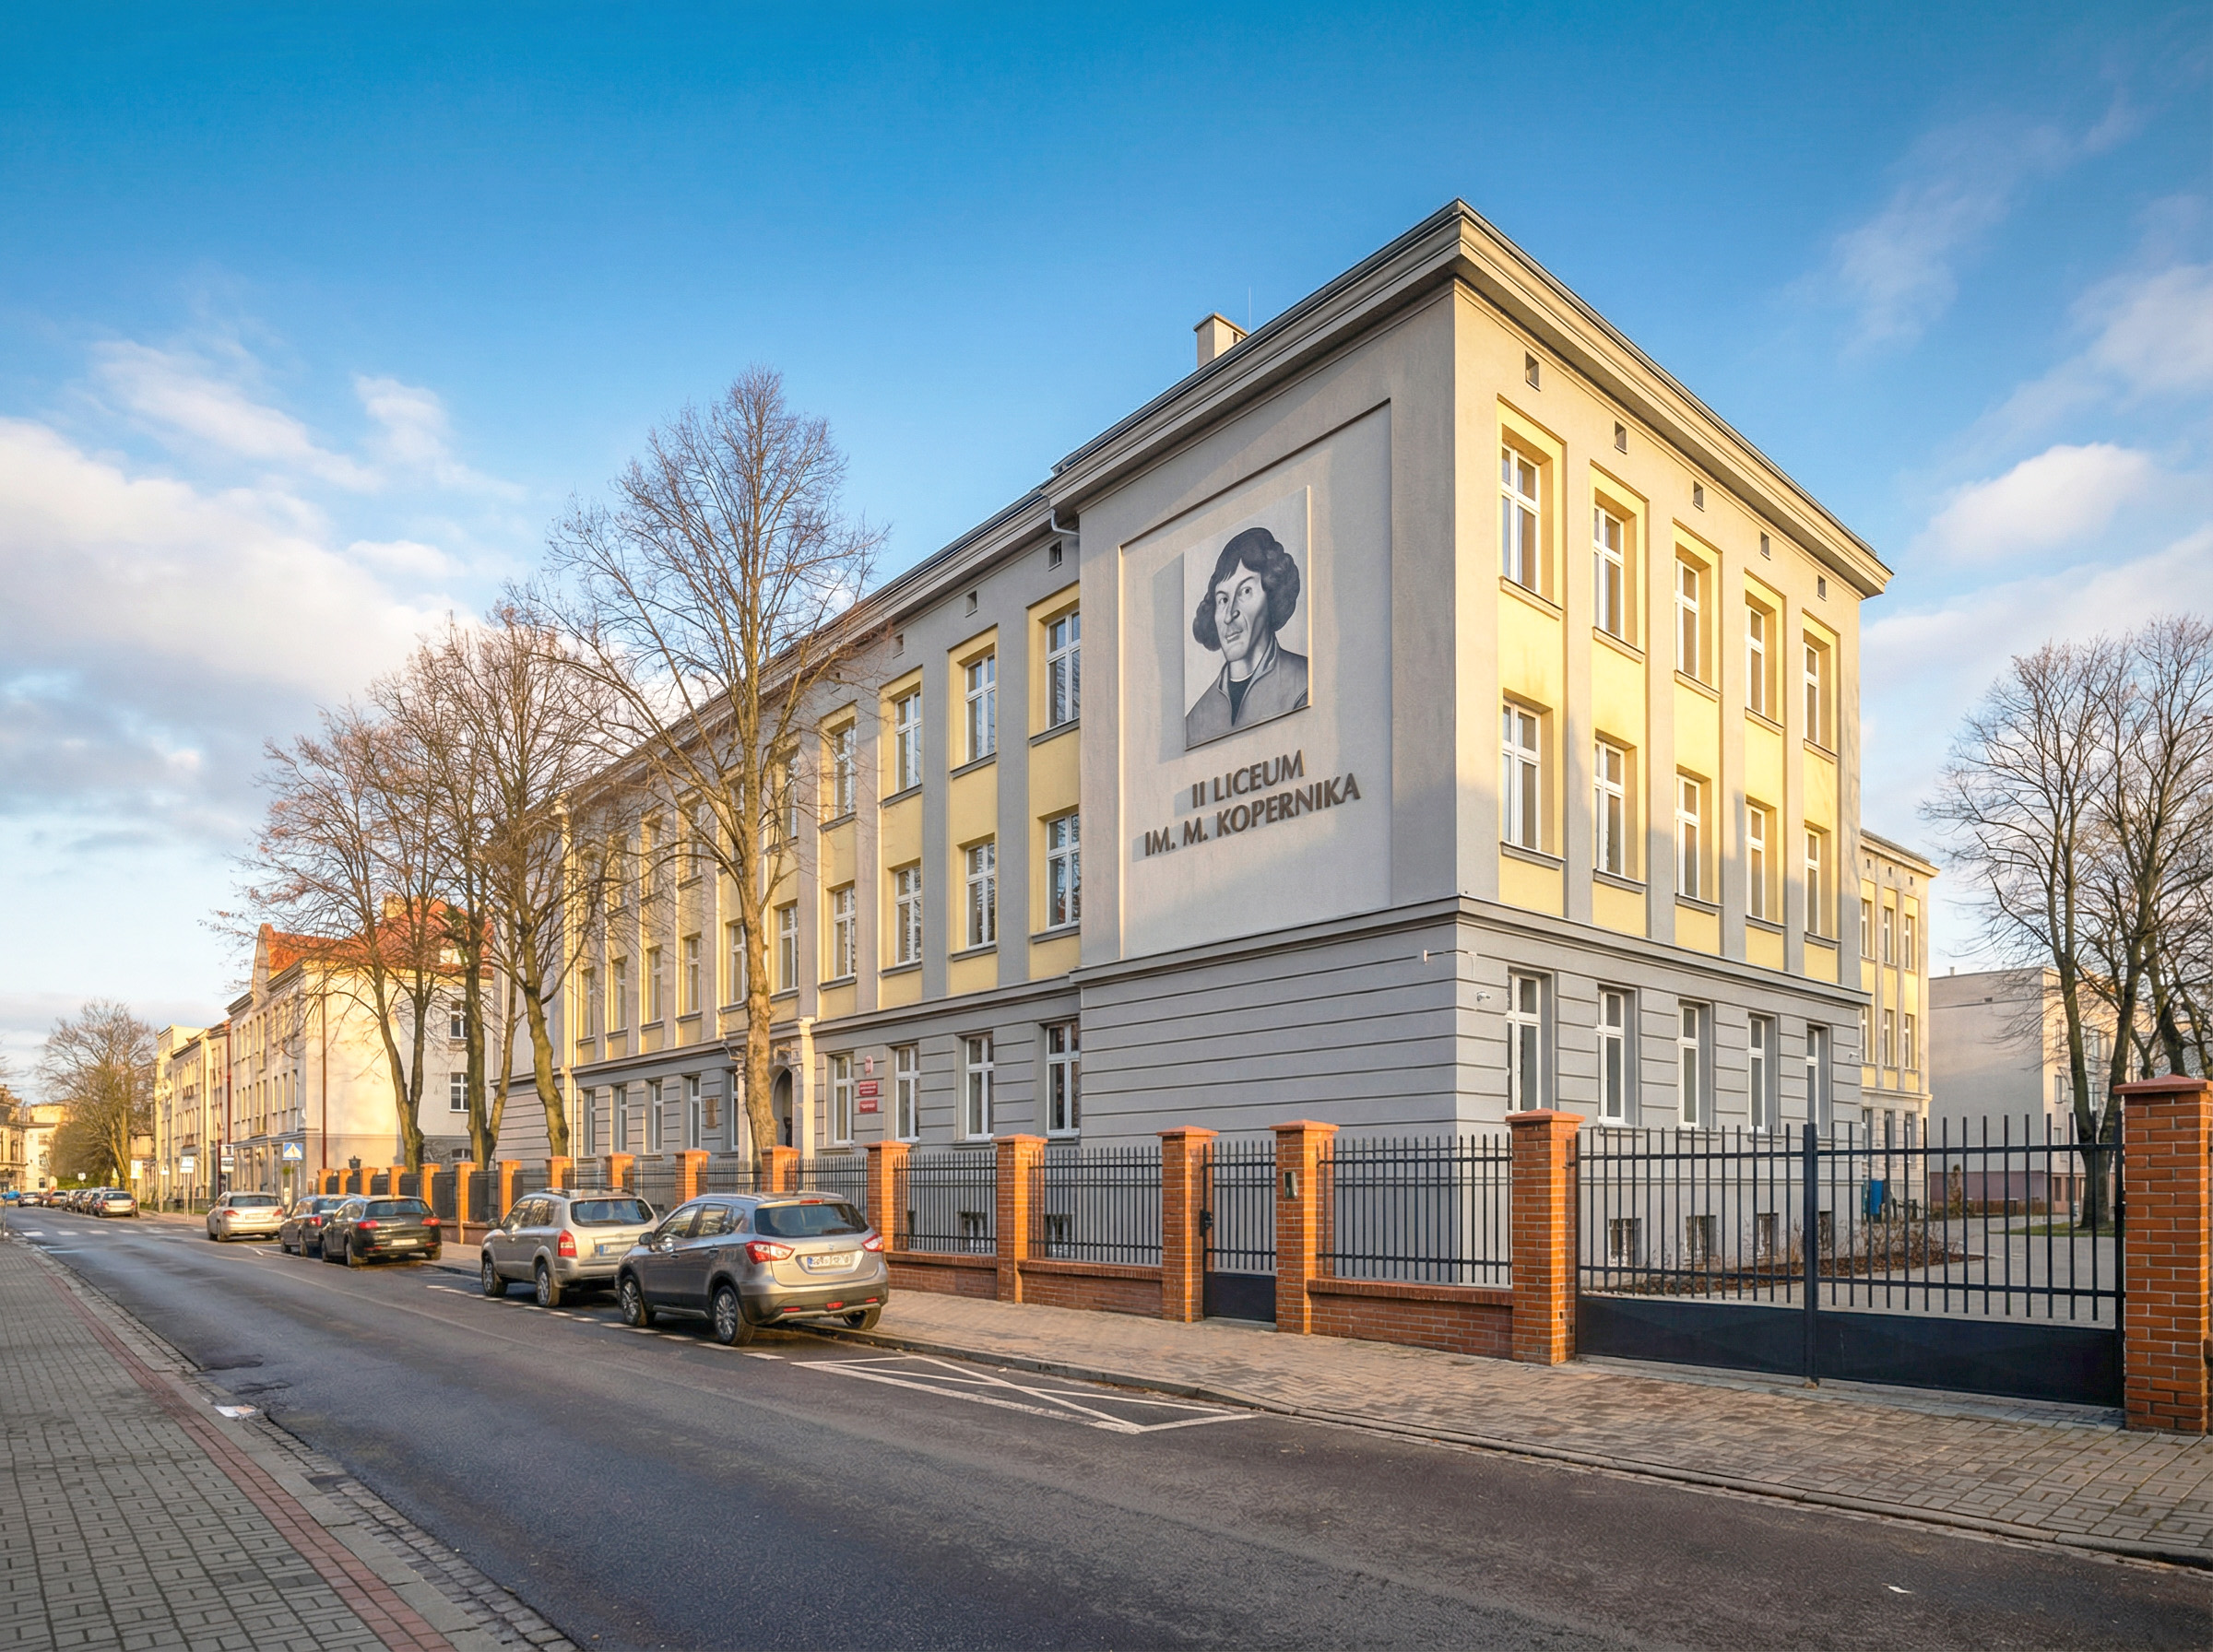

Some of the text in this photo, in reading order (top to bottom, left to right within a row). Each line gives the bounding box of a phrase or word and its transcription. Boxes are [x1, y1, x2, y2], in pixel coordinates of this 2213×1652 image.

[1192, 749, 1305, 808] II LICEUM
[1145, 773, 1361, 856] IM. M. KOPERNIKA
